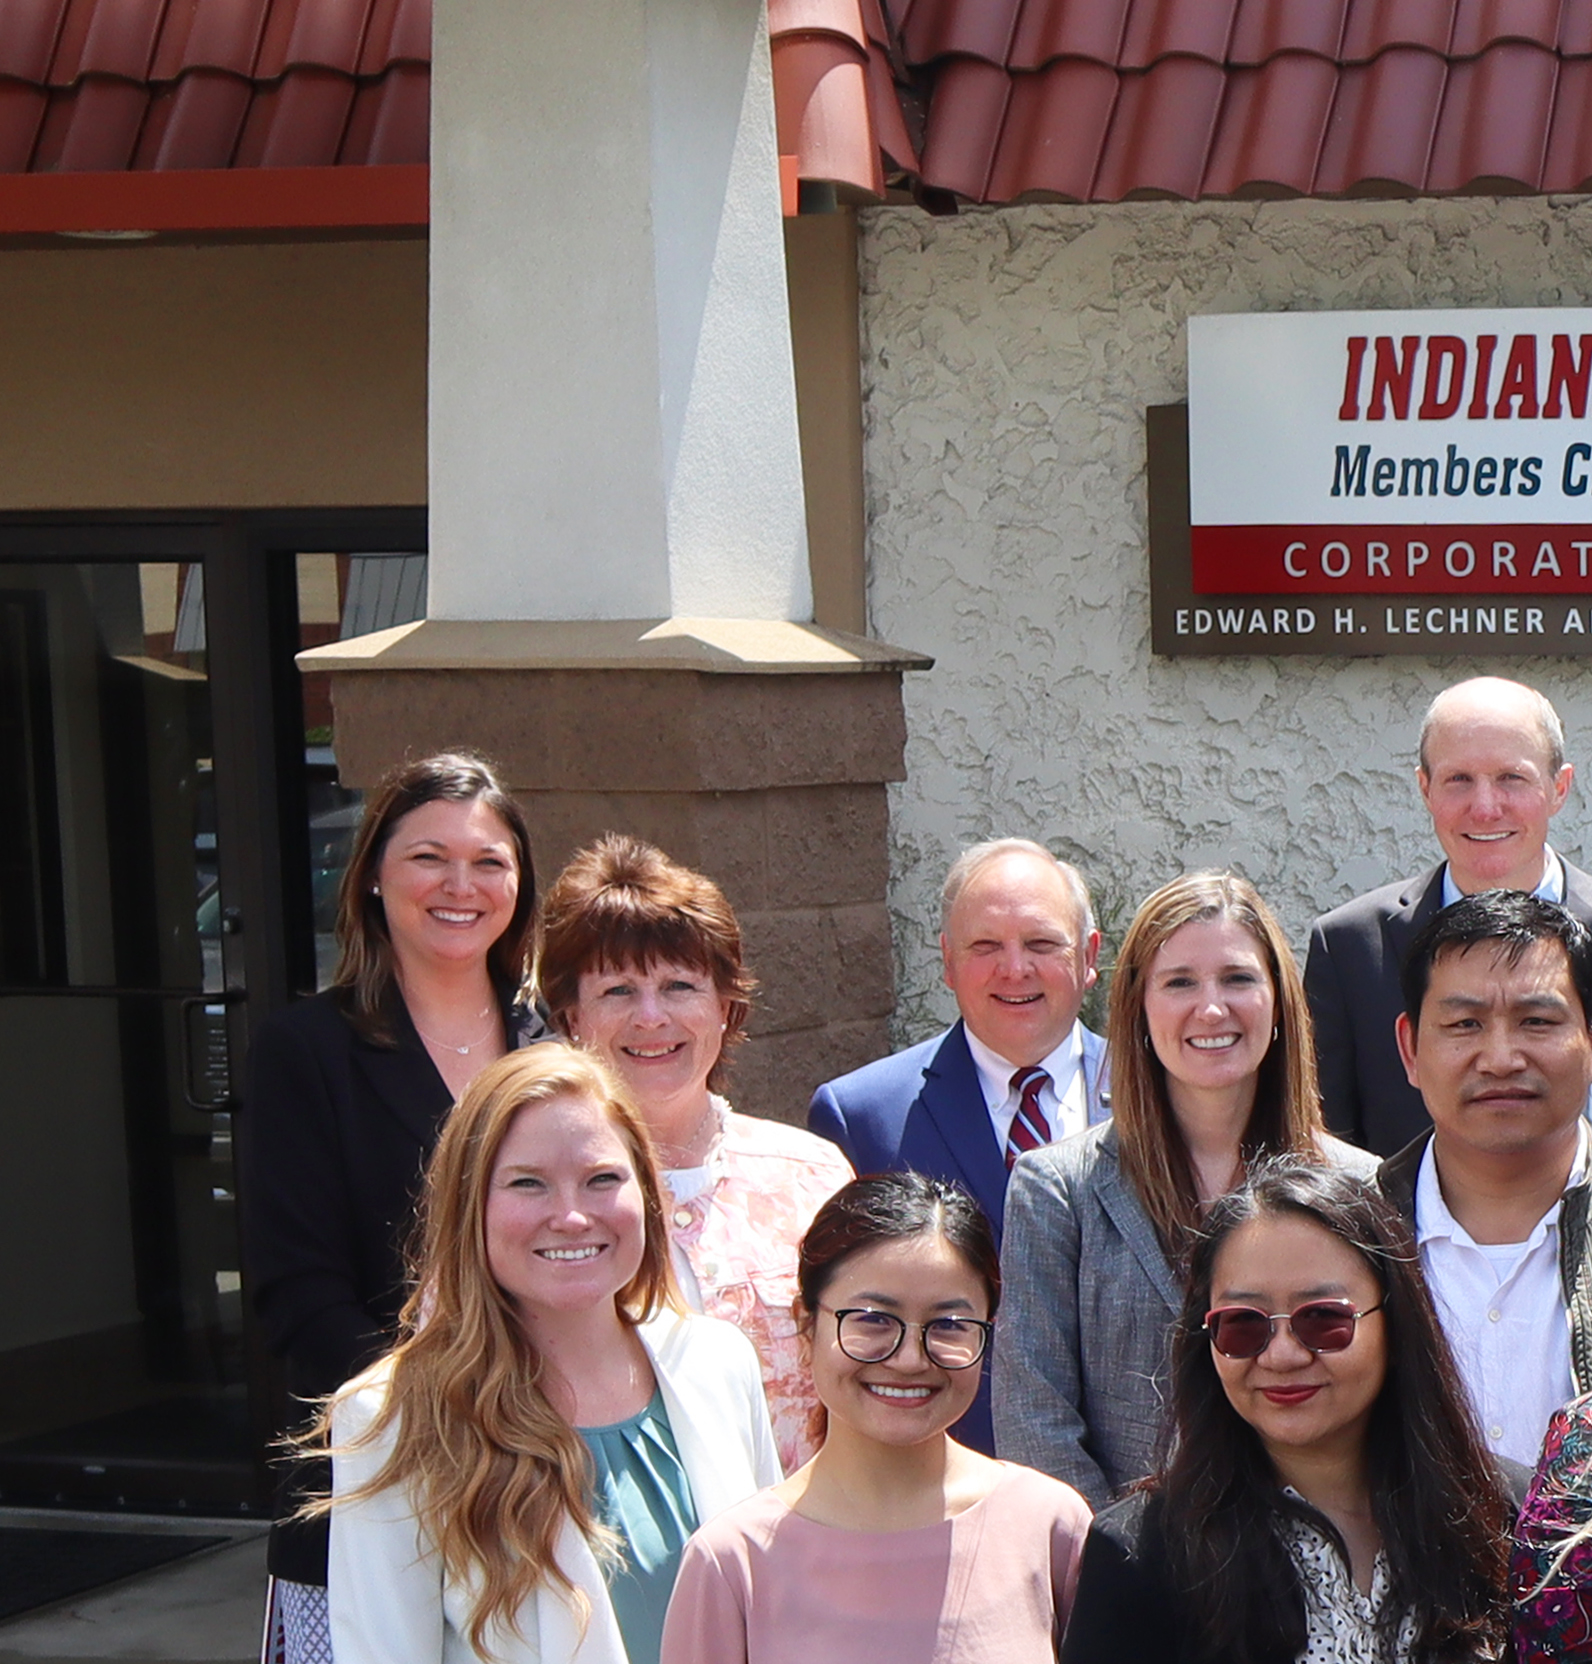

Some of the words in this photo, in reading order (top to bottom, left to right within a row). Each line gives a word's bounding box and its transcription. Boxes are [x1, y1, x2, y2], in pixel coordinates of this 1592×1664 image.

[1330, 443, 1541, 497] Members
[1175, 607, 1316, 636] EDWARD
[1335, 607, 1367, 636] H.
[1385, 607, 1545, 636] LECHNER
